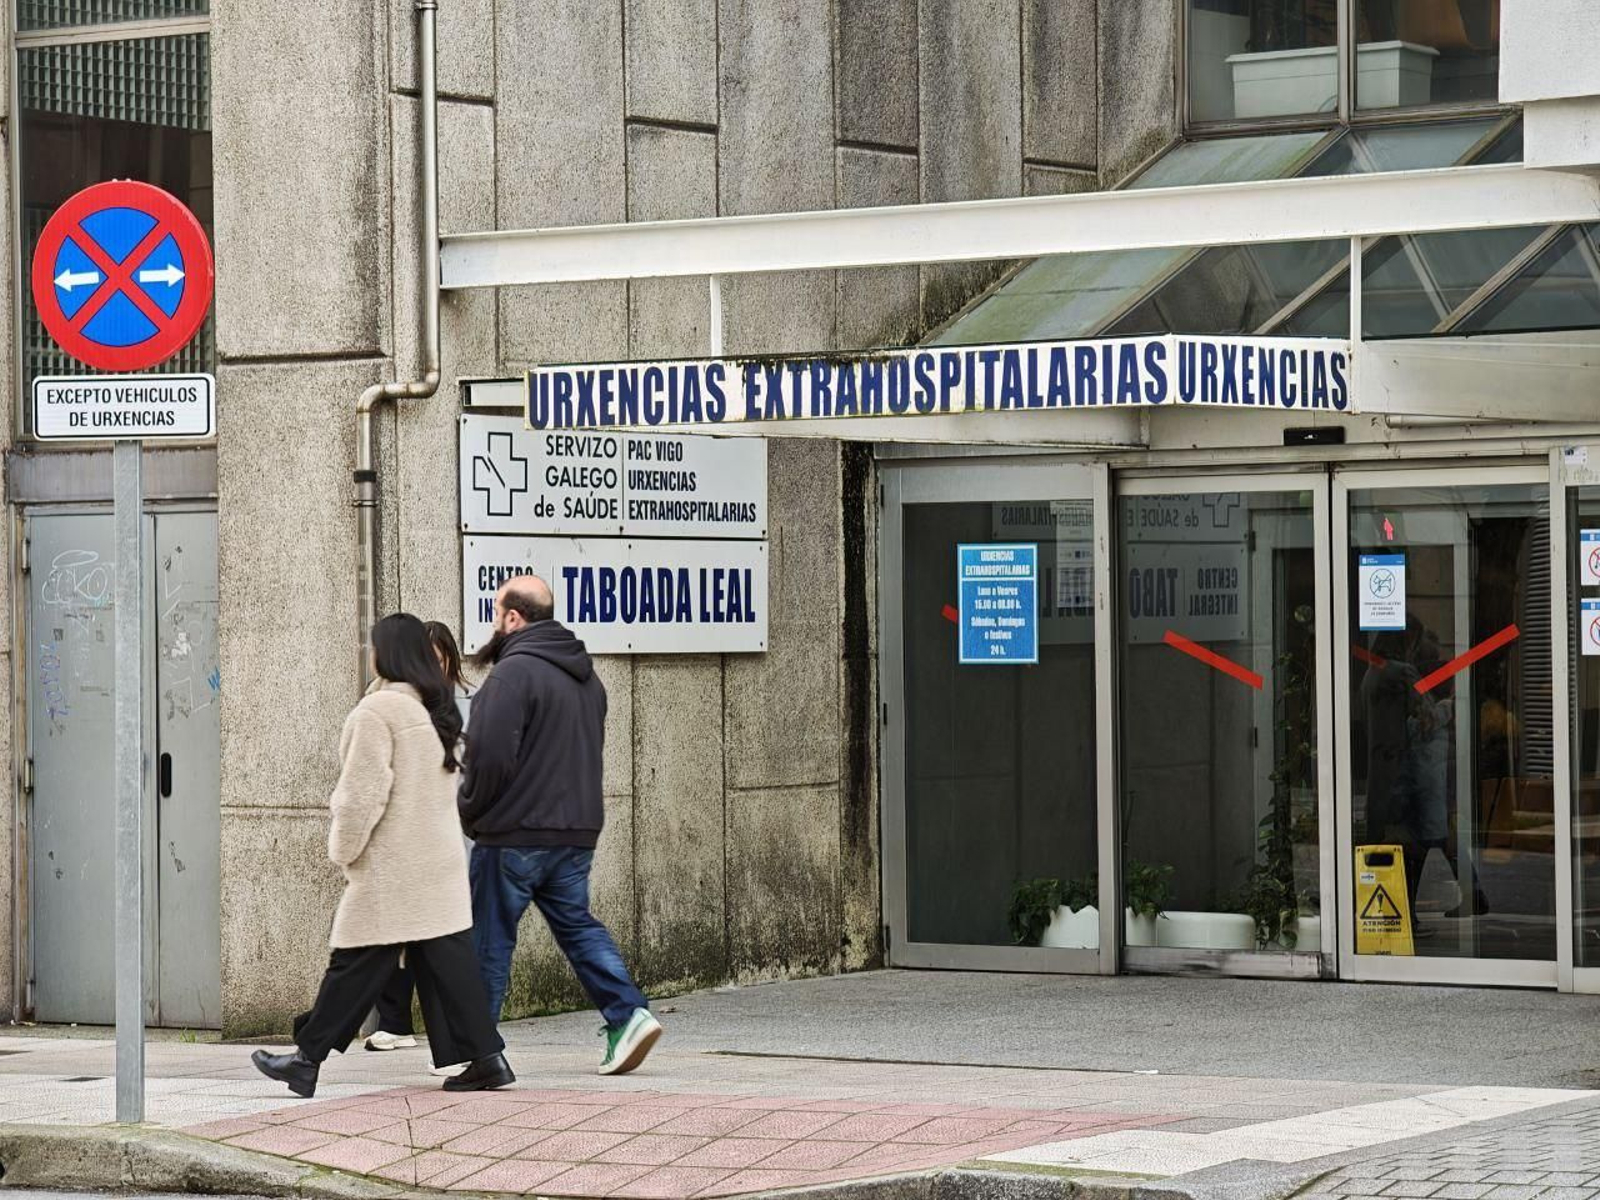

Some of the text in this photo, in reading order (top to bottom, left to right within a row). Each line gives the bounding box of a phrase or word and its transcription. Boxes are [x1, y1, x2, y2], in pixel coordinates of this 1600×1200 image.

[528, 341, 1168, 430] URXENCIAS EXTRAHOSPITALARIAS
[1178, 341, 1347, 411] URXENCIAS
[46, 386, 197, 404] EXCEPTO VEHICULOS
[69, 410, 175, 427] DE URXENCIAS
[545, 434, 617, 459] SERVIZO
[628, 440, 683, 462] PAC VIGO
[545, 466, 617, 489] GALEGO
[628, 471, 697, 492] URXENCIAS
[534, 490, 618, 520] de SAÚDE
[628, 499, 757, 522] EXTRAHOSPITALARIAS
[562, 566, 756, 624] TABOADA LEAL
